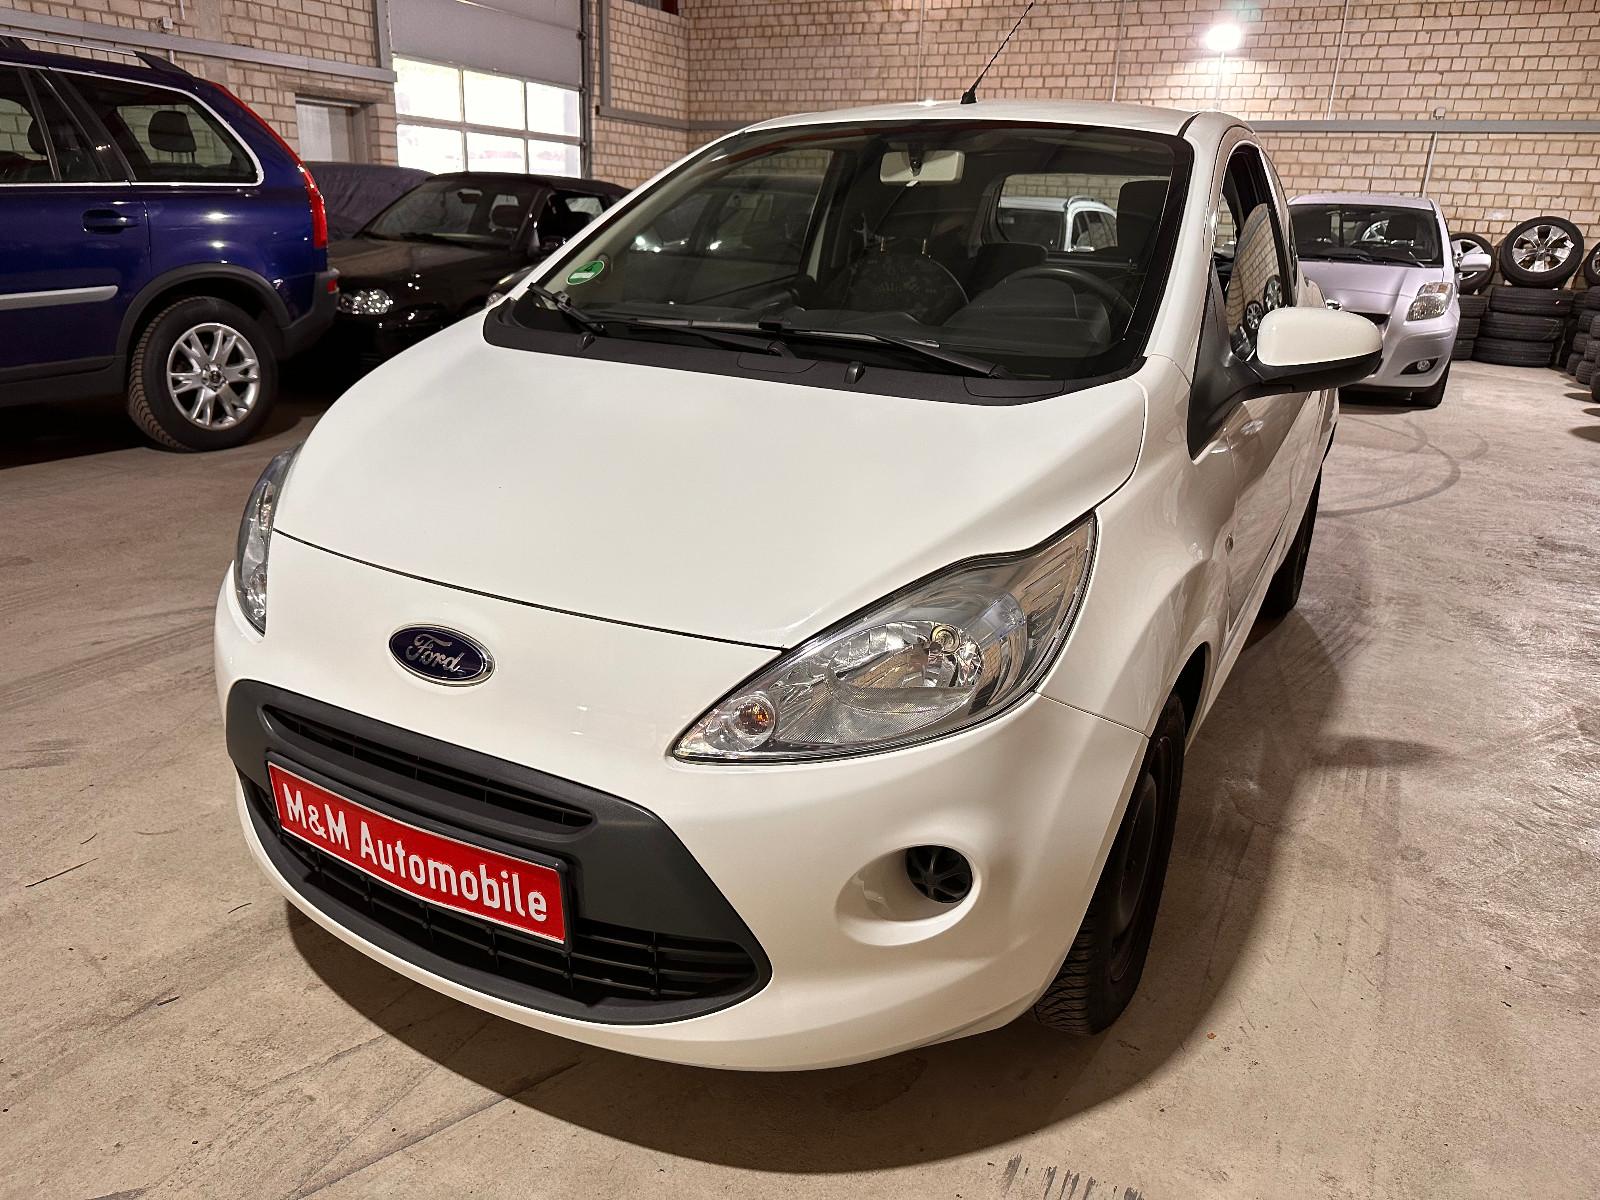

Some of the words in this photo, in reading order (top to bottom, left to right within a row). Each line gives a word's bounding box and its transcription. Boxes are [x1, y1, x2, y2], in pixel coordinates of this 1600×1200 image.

[405, 633, 465, 673] Ford
[282, 783, 351, 850] M&M
[360, 822, 548, 922] Automobile
